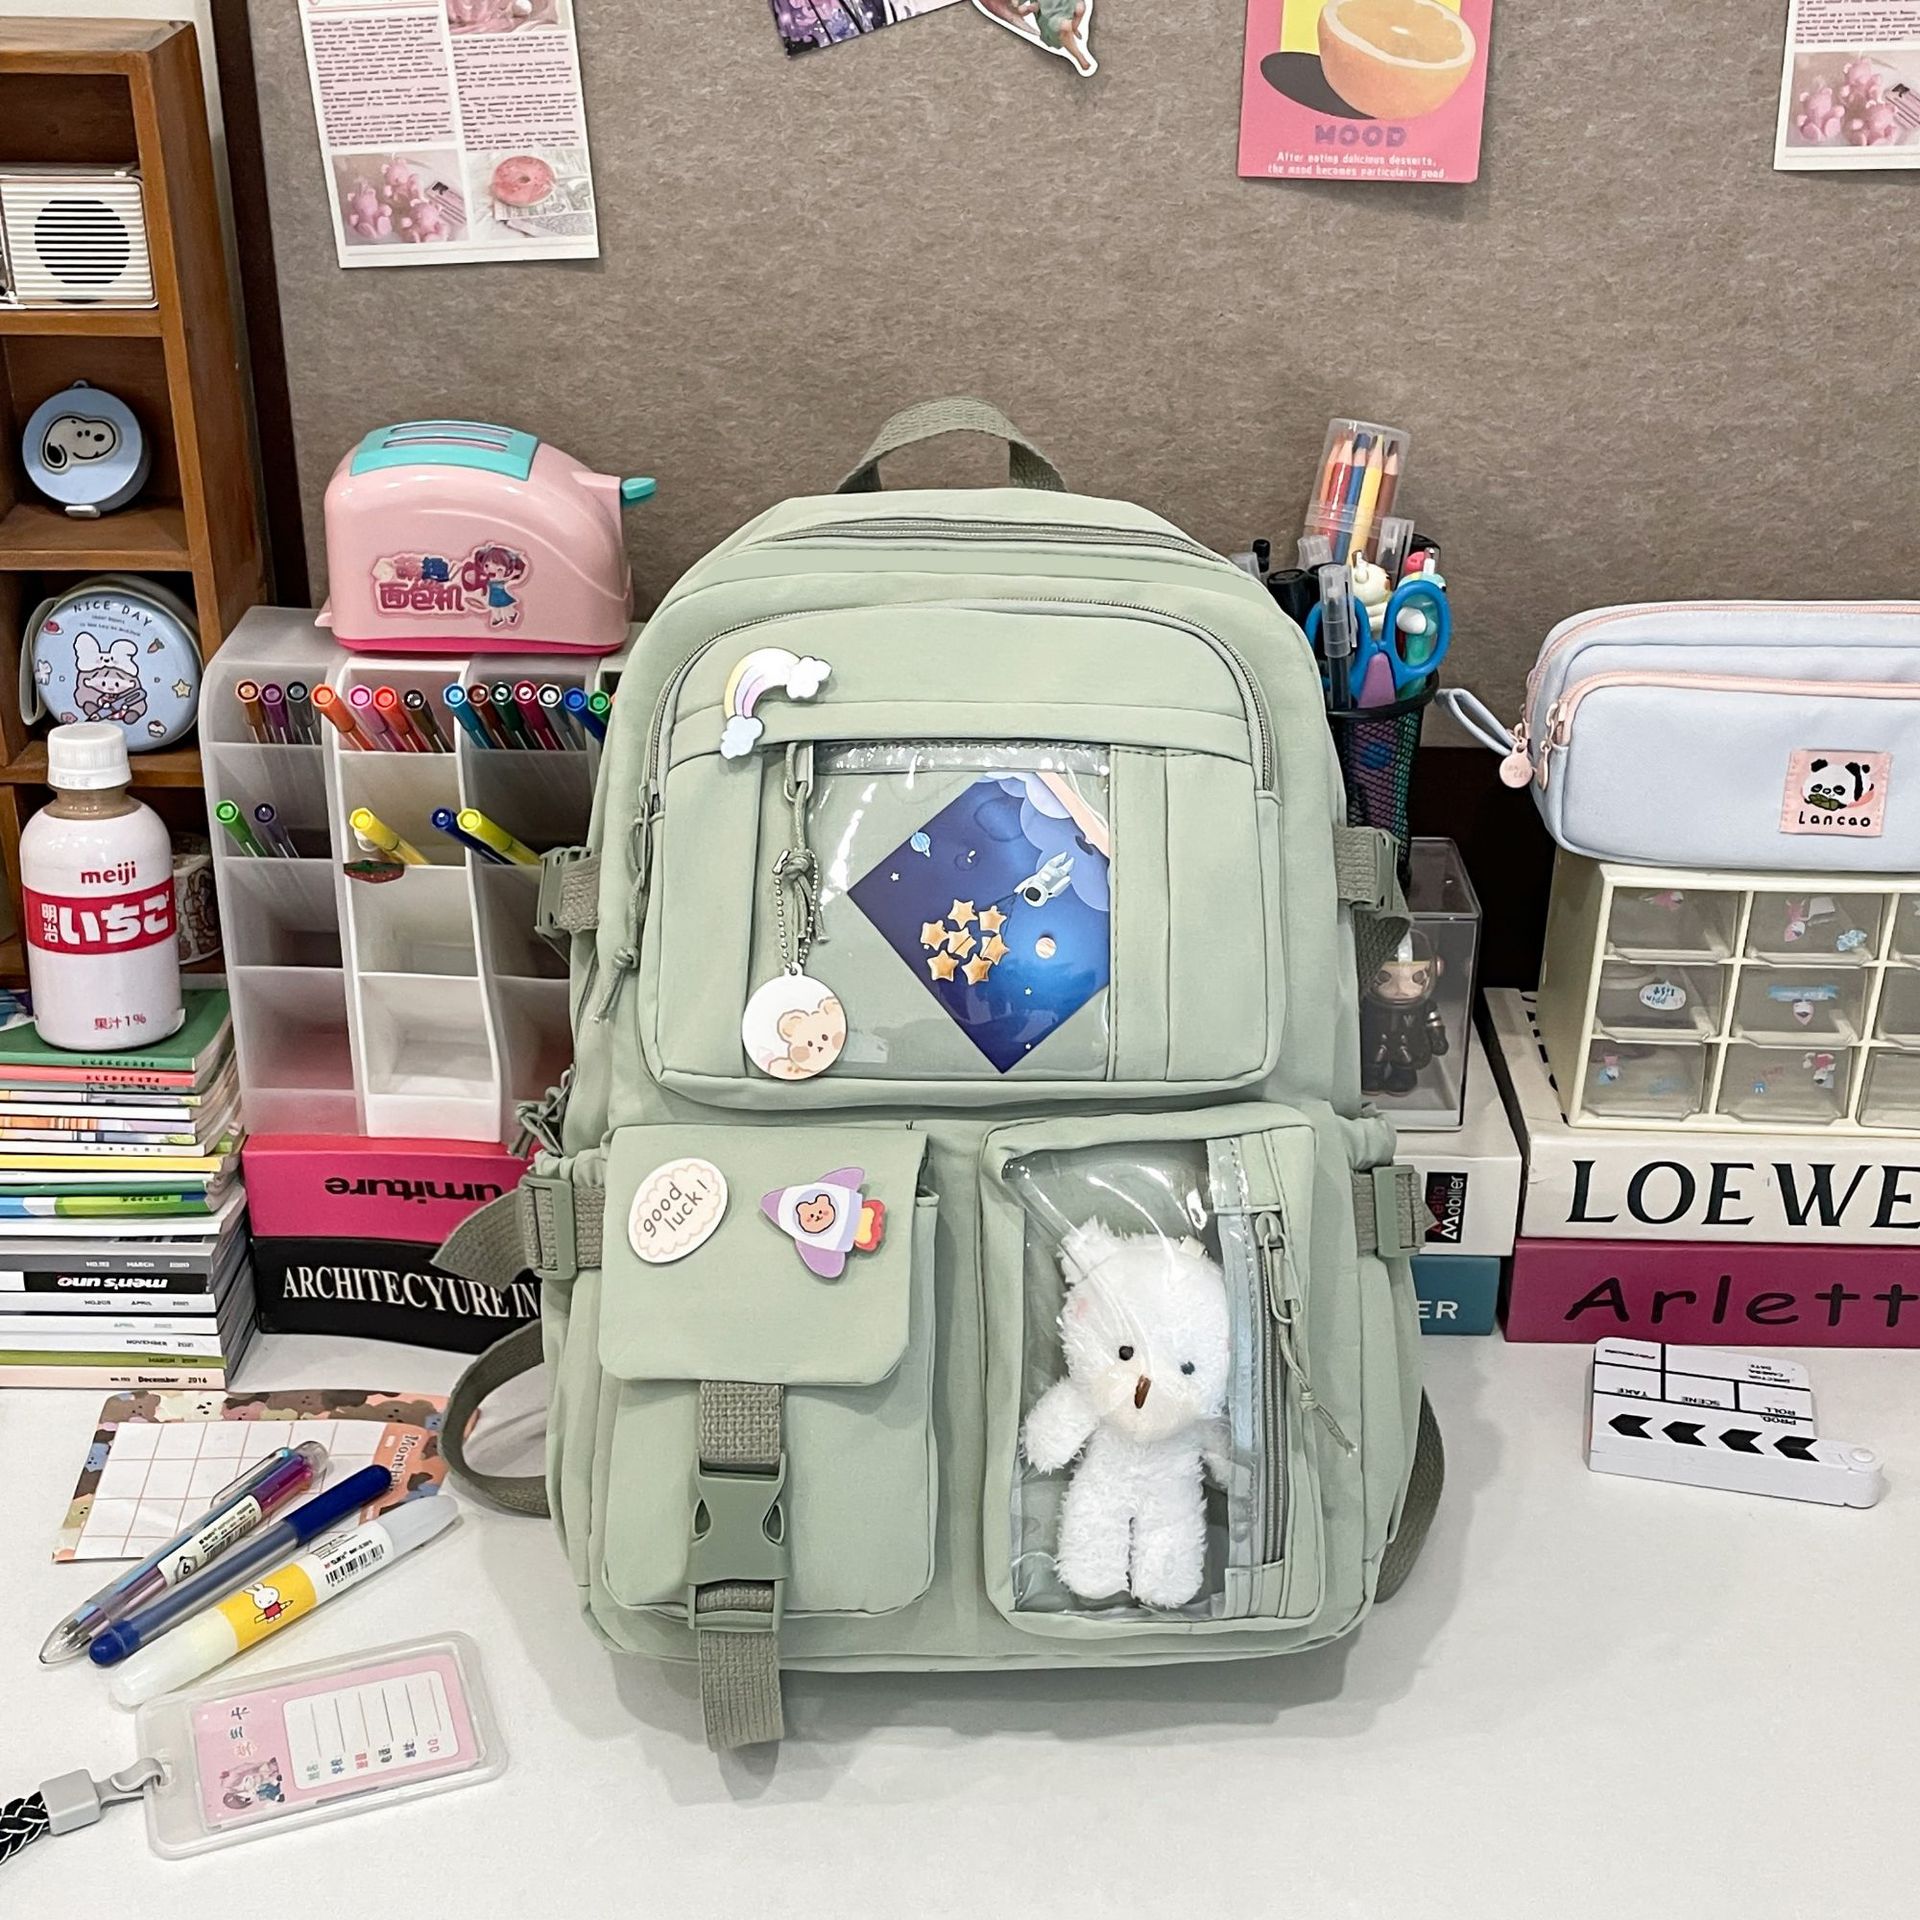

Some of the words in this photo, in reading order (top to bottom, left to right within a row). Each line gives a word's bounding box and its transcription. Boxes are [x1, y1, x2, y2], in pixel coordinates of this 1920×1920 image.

[1315, 125, 1407, 147] MOOD
[1308, 154, 1339, 164] eating
[1342, 154, 1385, 165] delicious
[1267, 164, 1285, 175] the
[1288, 165, 1312, 175] mood
[1316, 165, 1357, 177] becomes
[1360, 166, 1418, 179] particularly
[1421, 168, 1445, 179] good
[73, 599, 112, 614] NICE
[121, 604, 154, 627] DAY
[1798, 811, 1871, 827] Lancao
[80, 861, 137, 886] meiji
[1565, 1160, 1920, 1229] LOEWE
[643, 1181, 683, 1238] good
[663, 1179, 711, 1232] luck!
[1441, 1175, 1465, 1240] Mobilier
[58, 1276, 101, 1287] uno
[104, 1277, 168, 1290] men's
[138, 1375, 179, 1383] December
[188, 1376, 208, 1384] 2016
[1617, 1387, 1648, 1397] TAKE
[1682, 1396, 1720, 1407] SCENE
[1764, 1406, 1796, 1416] ROLL
[388, 1433, 419, 1492] Monthl
